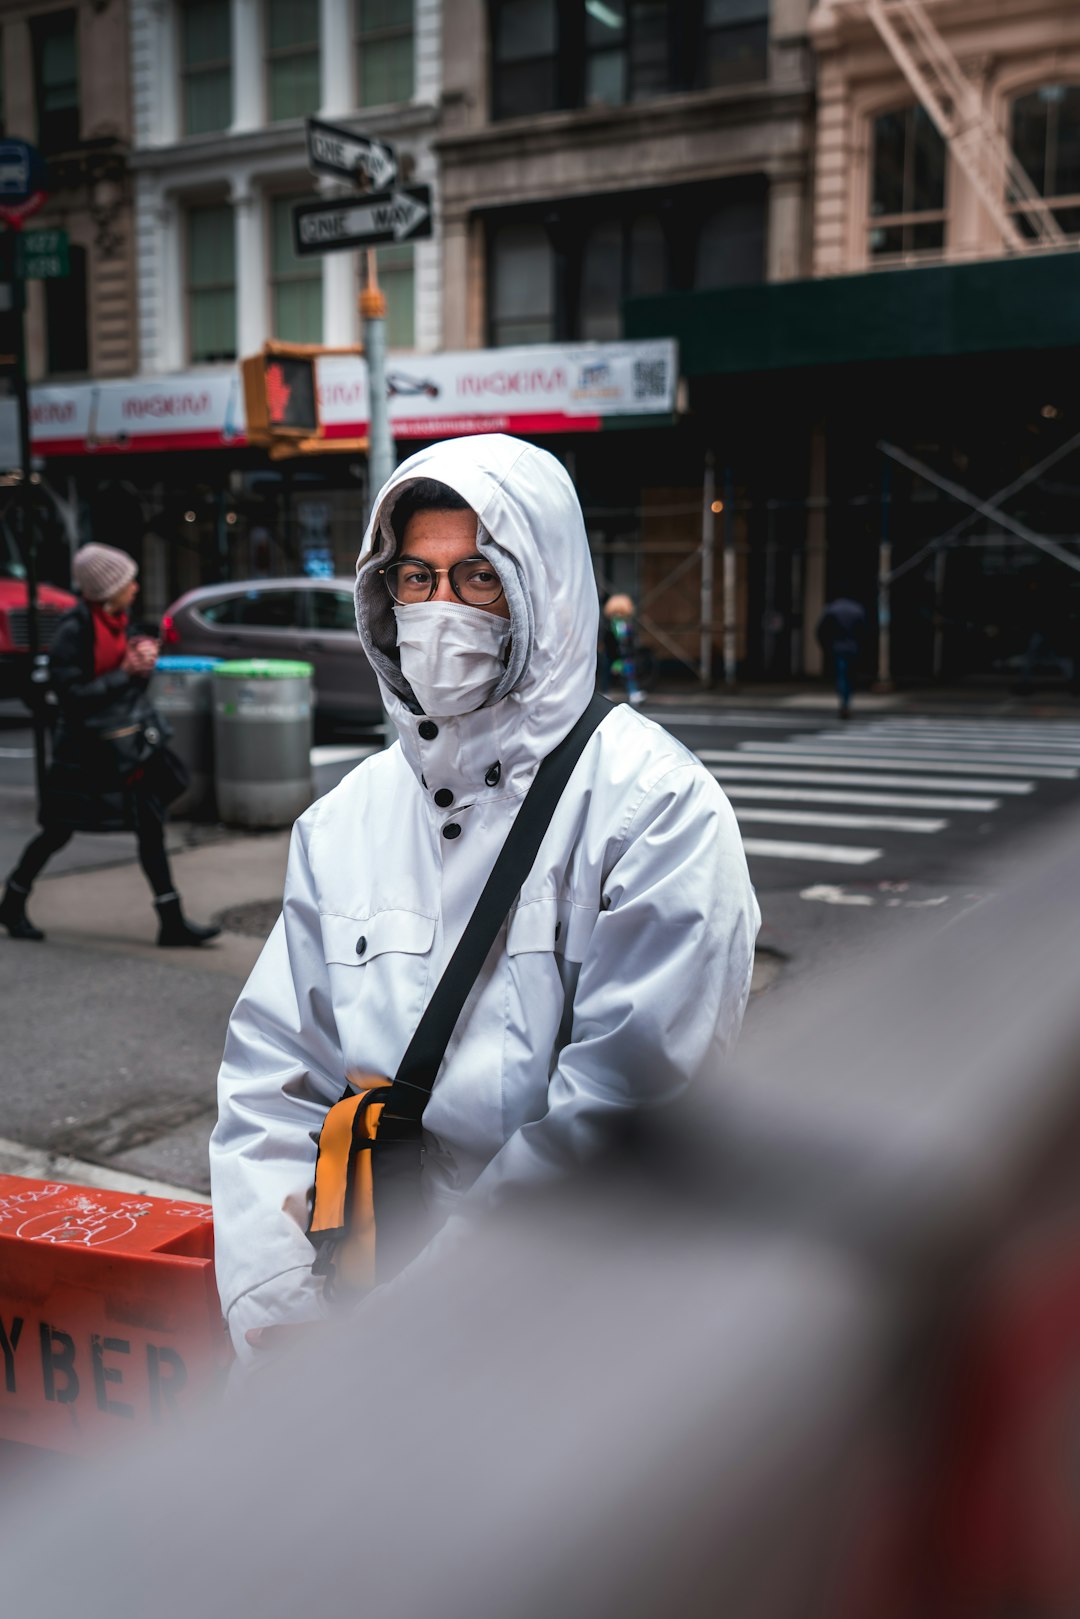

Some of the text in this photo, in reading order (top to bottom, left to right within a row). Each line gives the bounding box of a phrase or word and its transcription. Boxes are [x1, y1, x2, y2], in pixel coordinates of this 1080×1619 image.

[313, 136, 346, 166] ONE
[303, 205, 414, 241] ONE WAY
